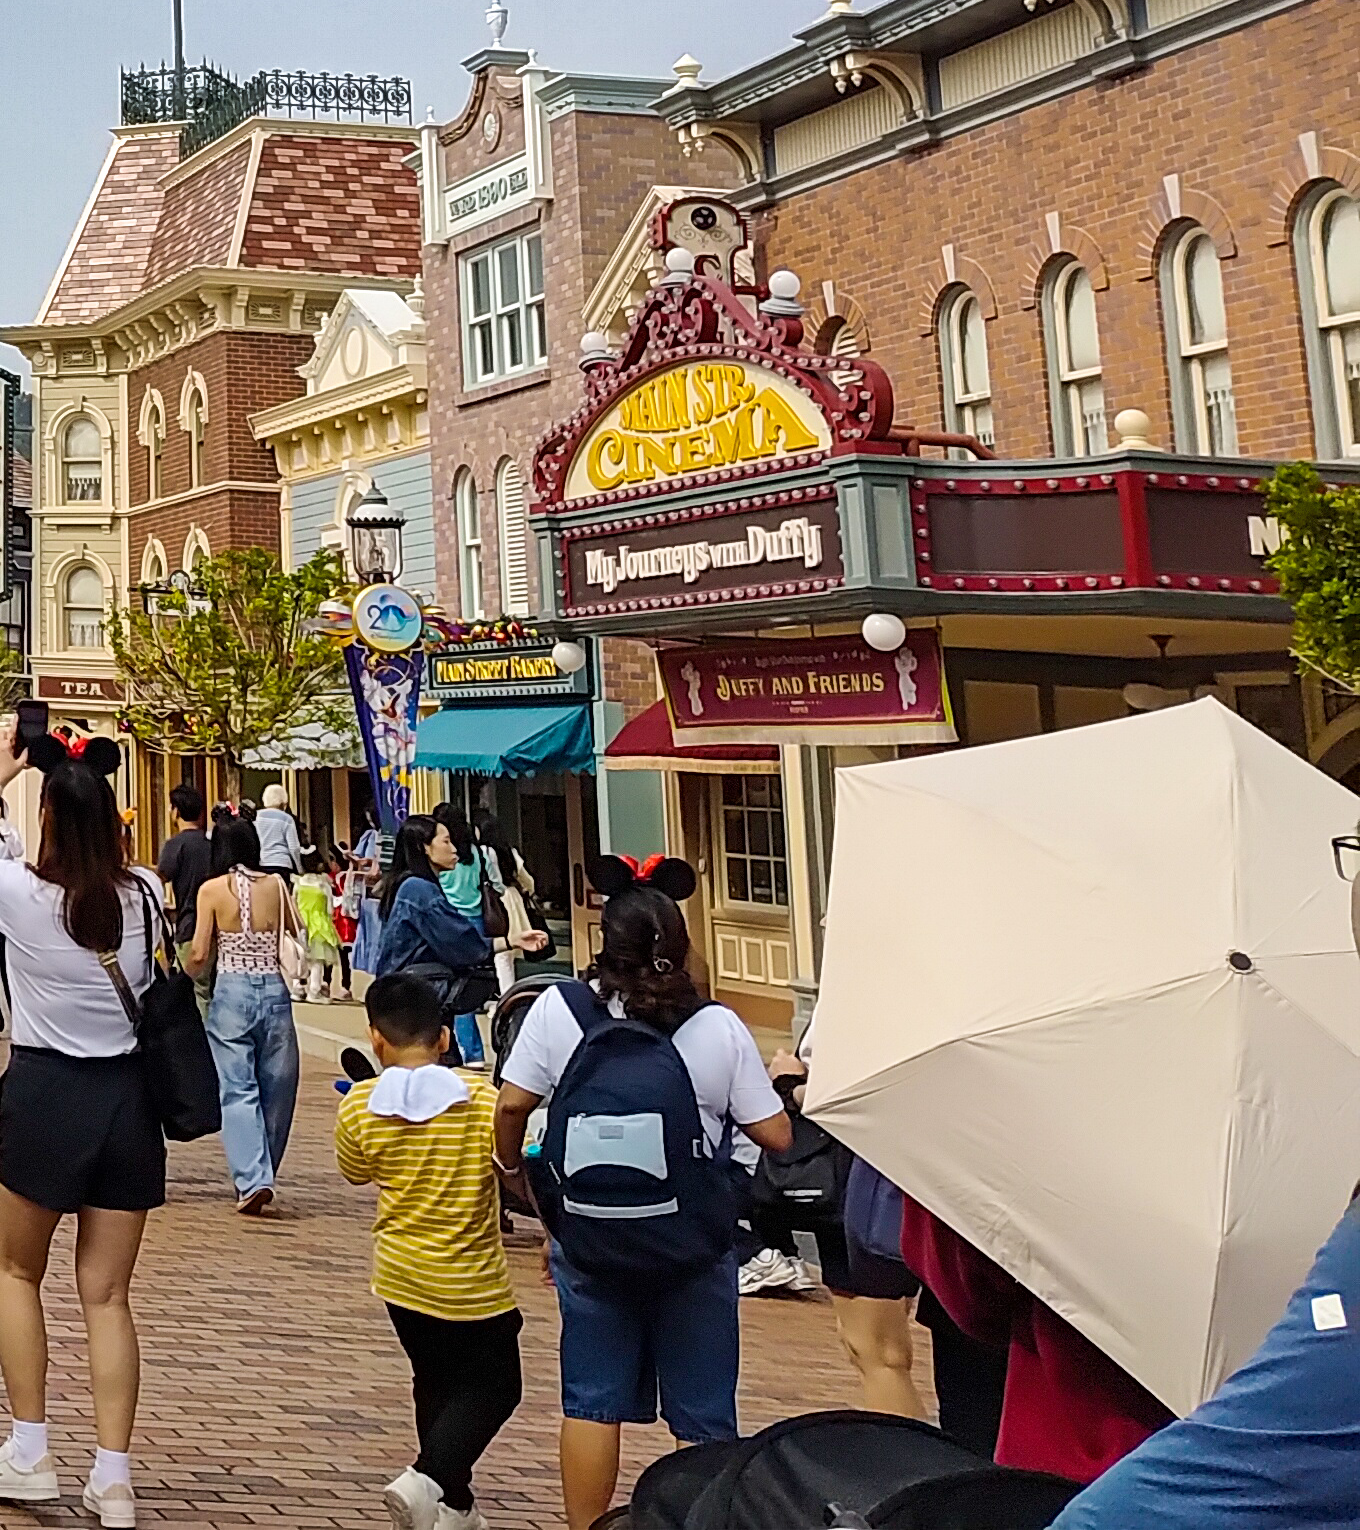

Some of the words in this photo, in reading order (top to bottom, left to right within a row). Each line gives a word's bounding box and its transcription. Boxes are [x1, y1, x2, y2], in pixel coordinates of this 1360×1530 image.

[618, 368, 691, 433] MAIN
[586, 386, 820, 490] CINEMA
[585, 548, 619, 594] My
[616, 541, 712, 584] Journeys
[746, 517, 823, 569] Duffy
[367, 604, 407, 632] 20
[436, 660, 465, 683] MAIN
[465, 658, 509, 681] STREET
[509, 655, 557, 679] BAKERY
[60, 681, 103, 696] TEA
[716, 674, 765, 701] DUFFY
[772, 676, 805, 696] AND
[806, 671, 886, 695] FRIENDS
